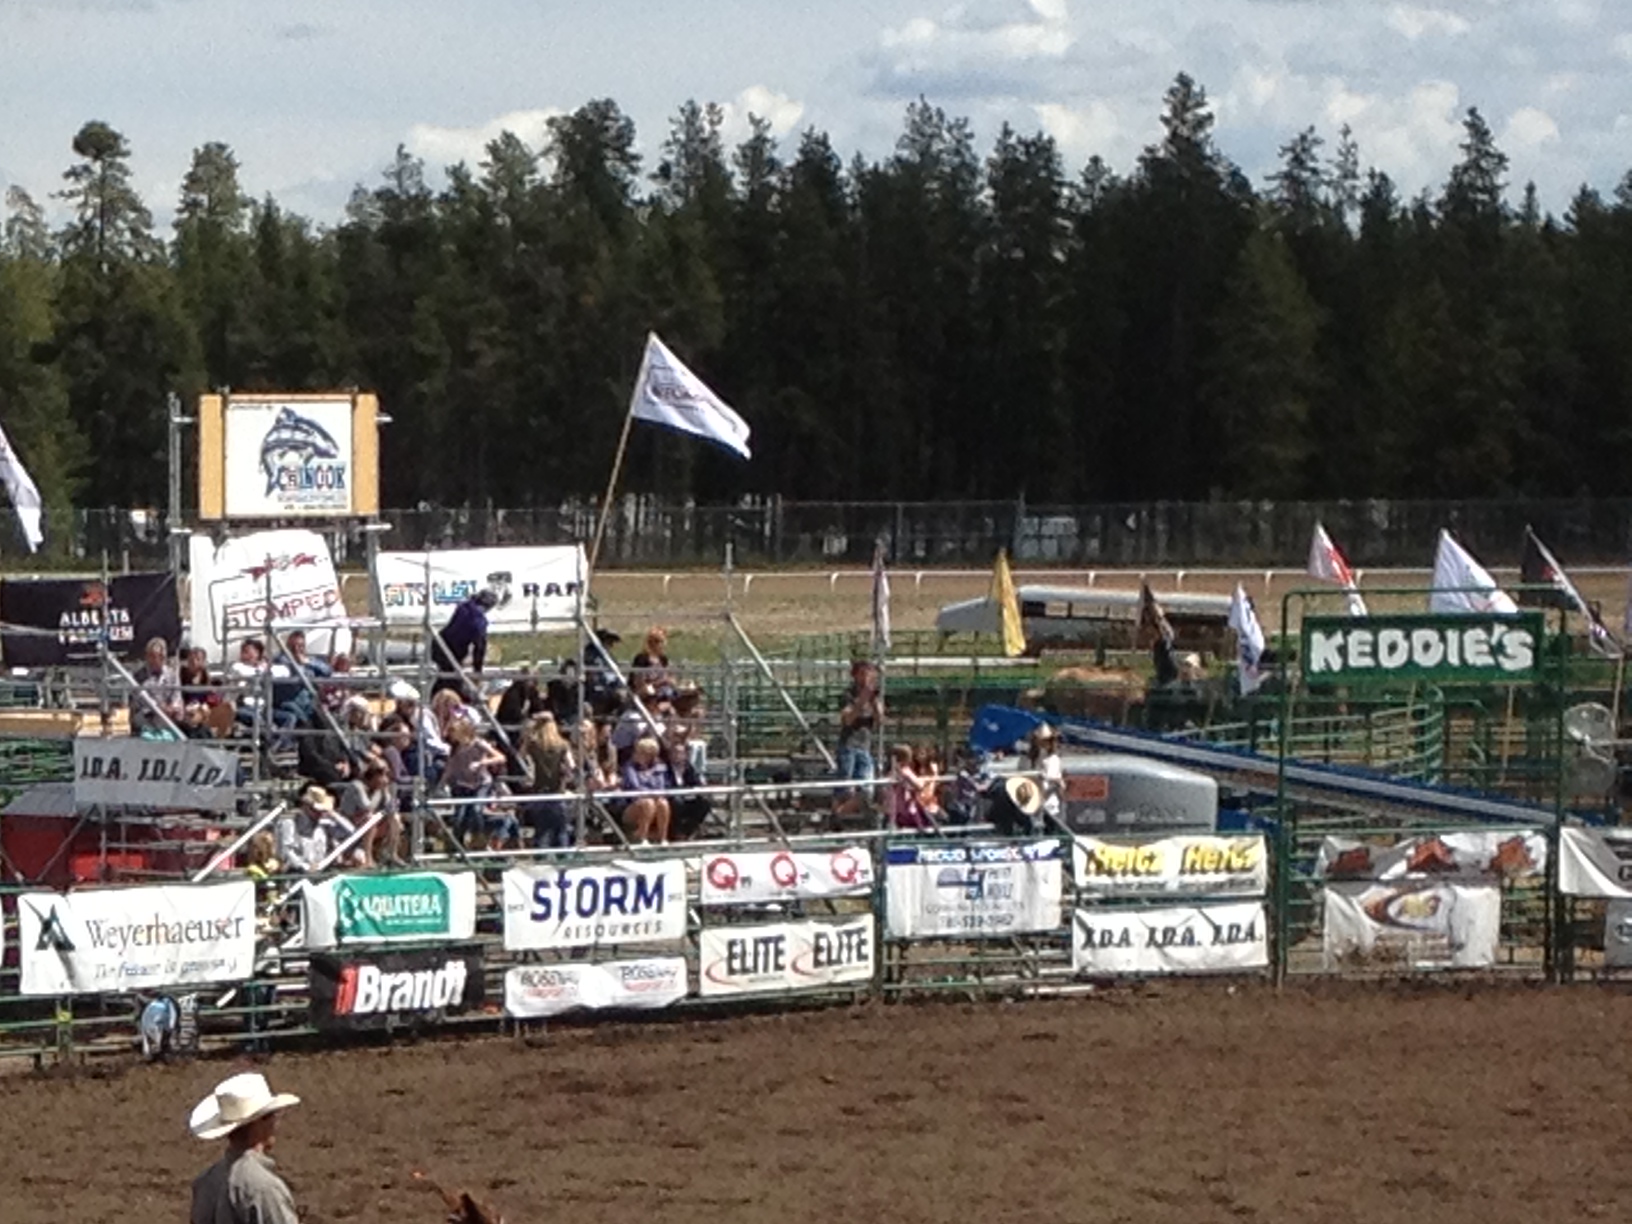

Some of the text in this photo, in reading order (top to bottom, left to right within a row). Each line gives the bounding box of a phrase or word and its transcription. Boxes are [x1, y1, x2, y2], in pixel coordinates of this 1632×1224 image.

[59, 609, 130, 627] ALBETA
[1310, 623, 1535, 673] KEDDIE'S
[85, 913, 244, 956] Weyerhaeuser
[727, 925, 869, 976] ELITE ELITE
[353, 959, 467, 1013] Brandt
